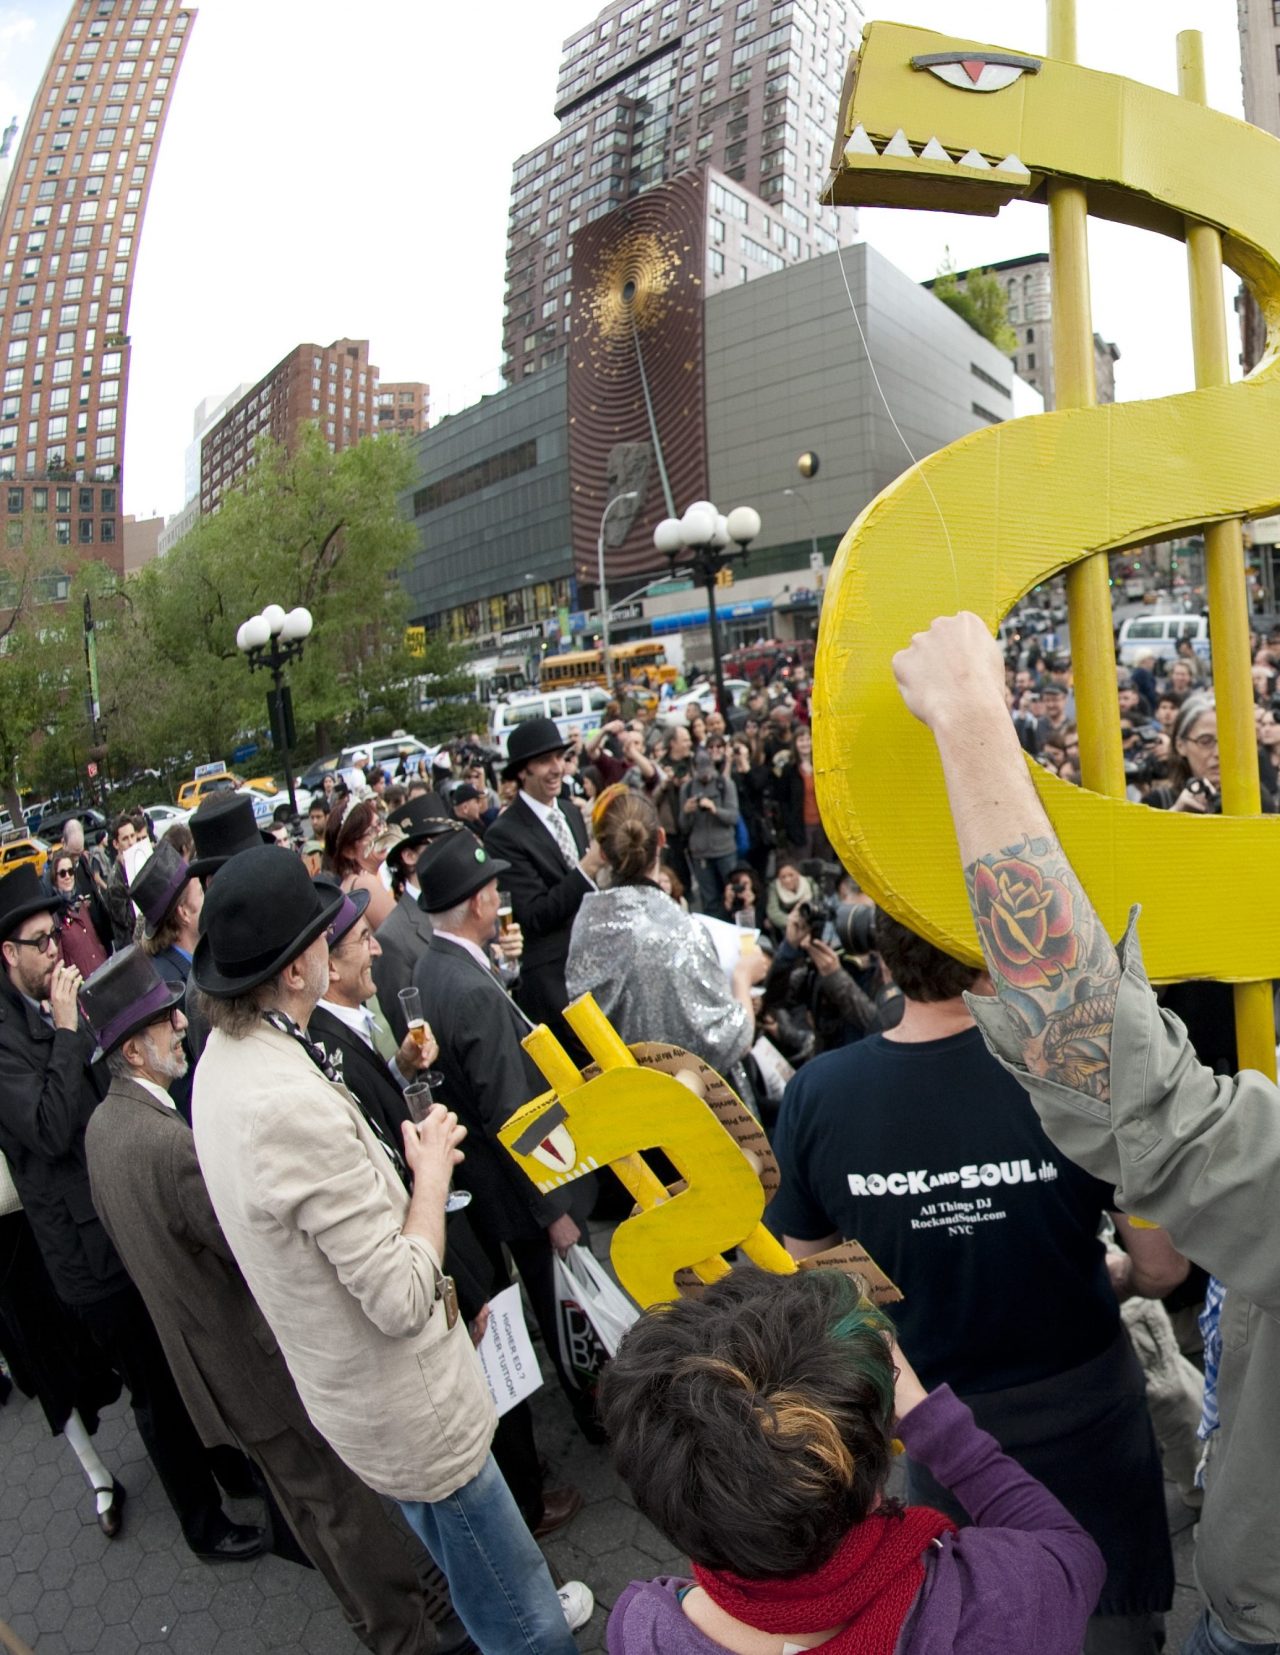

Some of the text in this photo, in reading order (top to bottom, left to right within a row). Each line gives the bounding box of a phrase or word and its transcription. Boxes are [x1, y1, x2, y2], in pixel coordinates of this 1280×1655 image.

[919, 1198, 993, 1217] All Things DJ
[910, 1209, 1007, 1230] RockandSoul.com
[948, 1225, 975, 1237] NYC
[488, 1310, 518, 1400] HIGHER TUITION!
[502, 1312, 526, 1381] HIGHER ED.?
